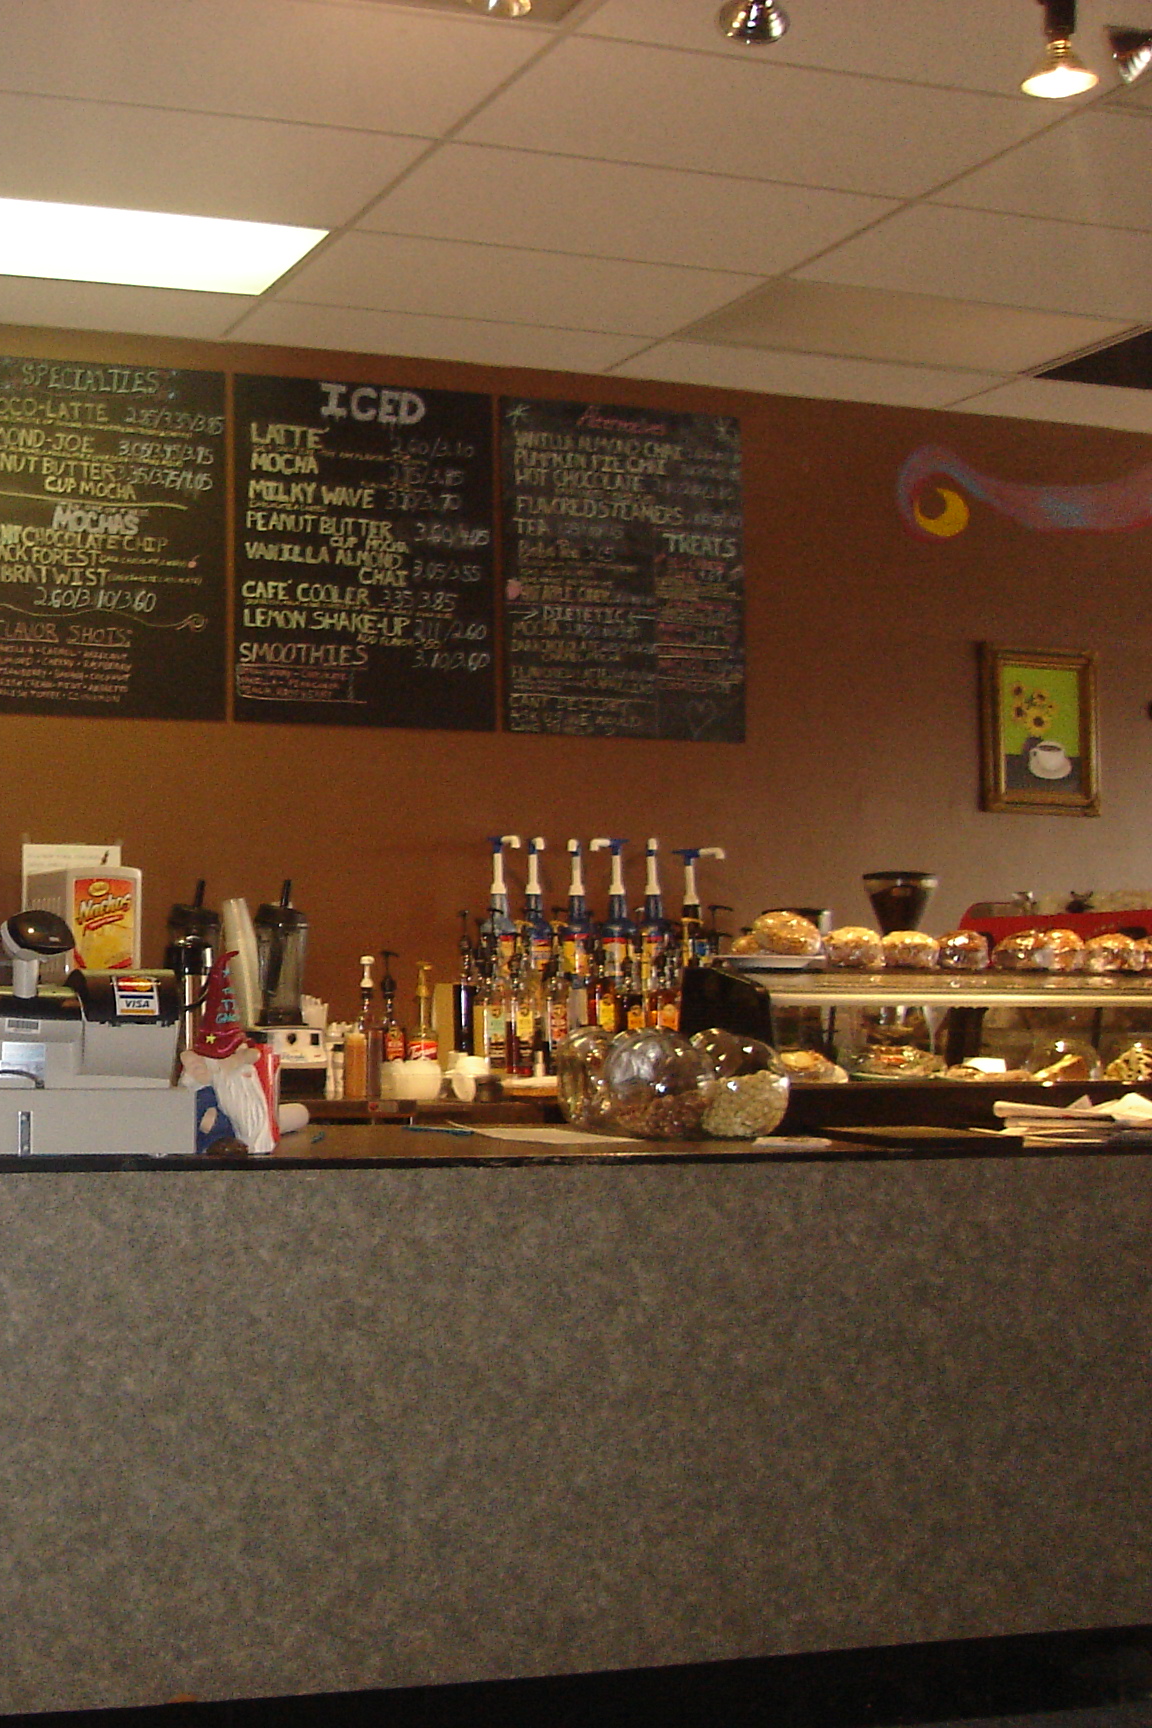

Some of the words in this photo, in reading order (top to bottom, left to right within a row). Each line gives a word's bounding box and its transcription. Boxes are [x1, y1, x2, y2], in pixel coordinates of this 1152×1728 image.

[22, 363, 160, 394] SPECIALTIES
[320, 382, 426, 425] ICED
[42, 458, 116, 481] BUTTER
[250, 453, 318, 475] MOCHA
[44, 476, 76, 494] CUP
[79, 479, 137, 500] MOCHA
[515, 468, 549, 487] HOT
[248, 480, 317, 504] MILKY
[322, 486, 375, 509] WAVE
[53, 505, 140, 535] MOCHAS
[246, 511, 317, 533] PEANUT
[319, 516, 392, 541] BUTTER
[513, 517, 550, 536] TEA
[23, 526, 116, 551] CHOCOLATE
[123, 536, 168, 552] CHIP
[330, 536, 358, 549] CUP
[663, 533, 737, 558] TREATS
[32, 547, 100, 567] FOREST
[245, 541, 329, 564] VANILLA
[336, 549, 403, 569] ALMOND
[359, 568, 408, 587] CHAI
[296, 582, 370, 606] COOLER
[244, 608, 306, 630] LEMON
[311, 611, 410, 637] SHAKE-UP
[239, 642, 368, 666] SMOOTHIES
[124, 999, 151, 1010] VISA
